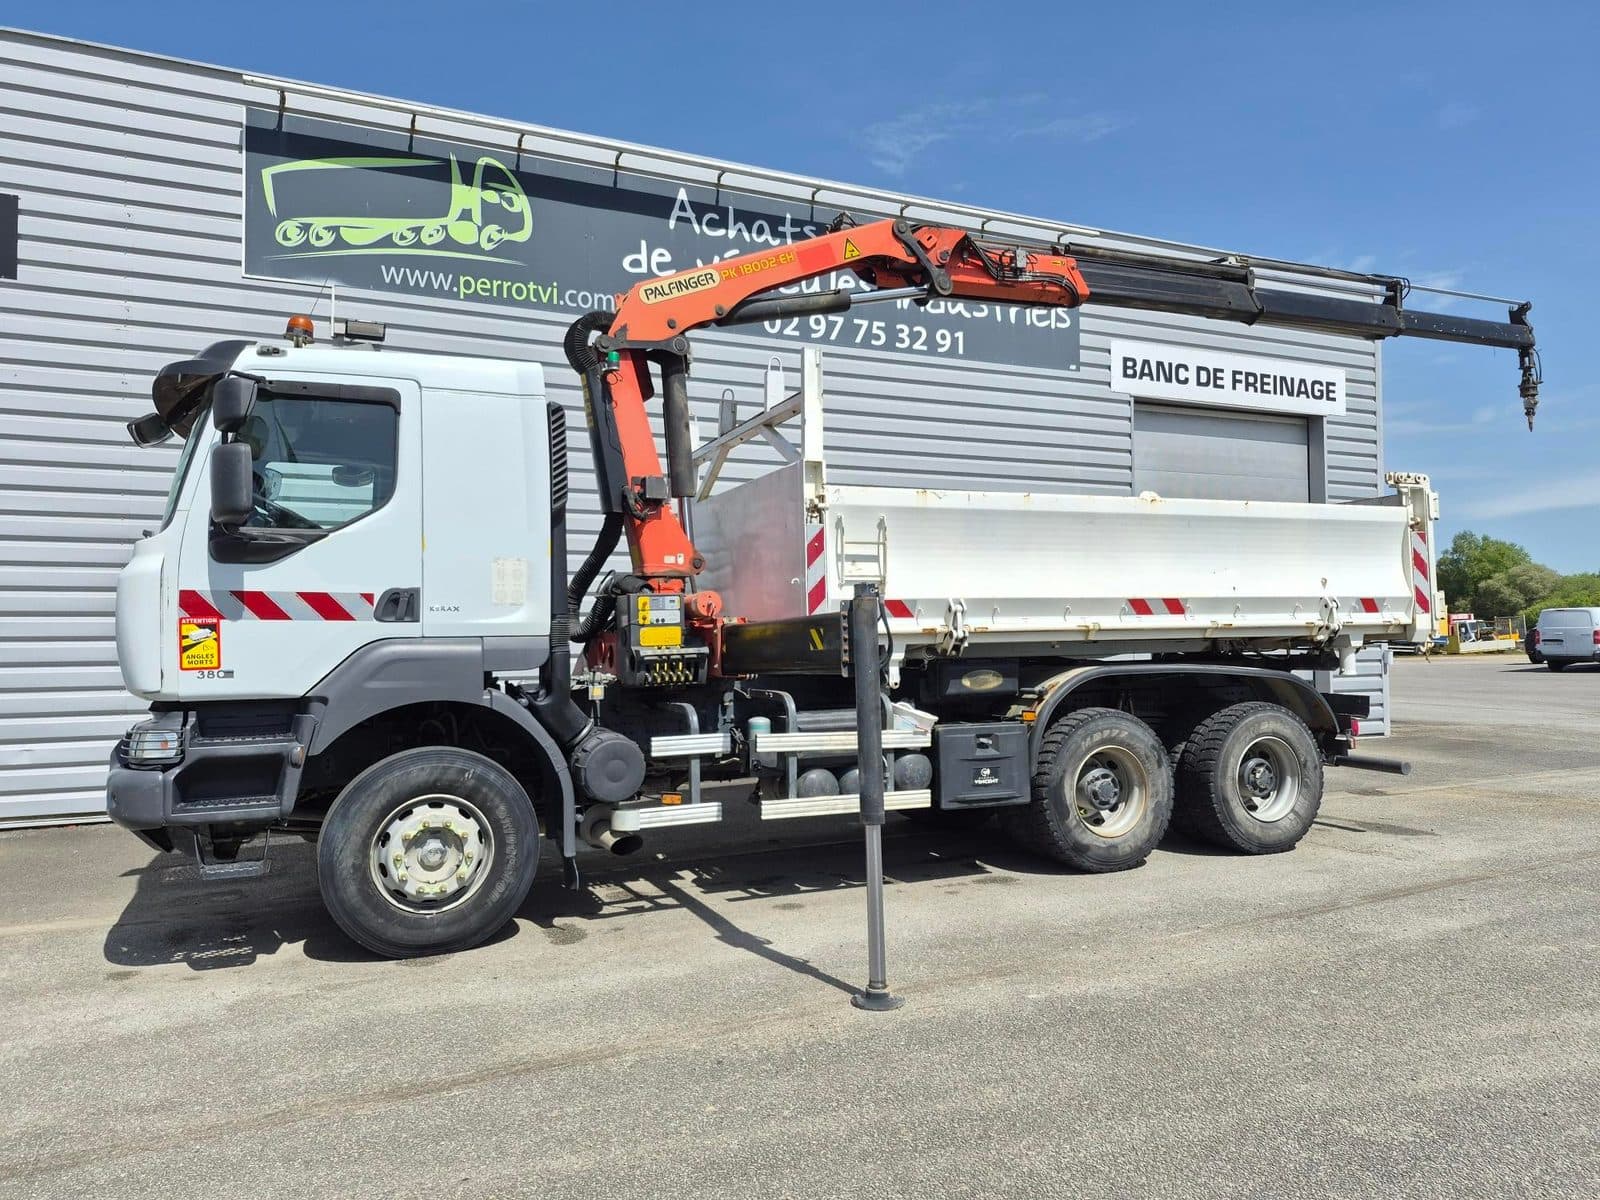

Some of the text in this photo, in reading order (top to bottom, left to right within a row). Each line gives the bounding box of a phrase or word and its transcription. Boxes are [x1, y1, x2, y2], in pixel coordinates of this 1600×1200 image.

[622, 240, 676, 277] de
[720, 268, 737, 281] PK
[381, 264, 616, 312] www.perrotvi.com
[644, 272, 716, 301] PALFINGER
[809, 314, 845, 340] 97
[853, 318, 886, 346] 75
[895, 324, 928, 350] 32
[936, 329, 964, 355] 91
[1122, 356, 1337, 402] BANC DE FREINAGE
